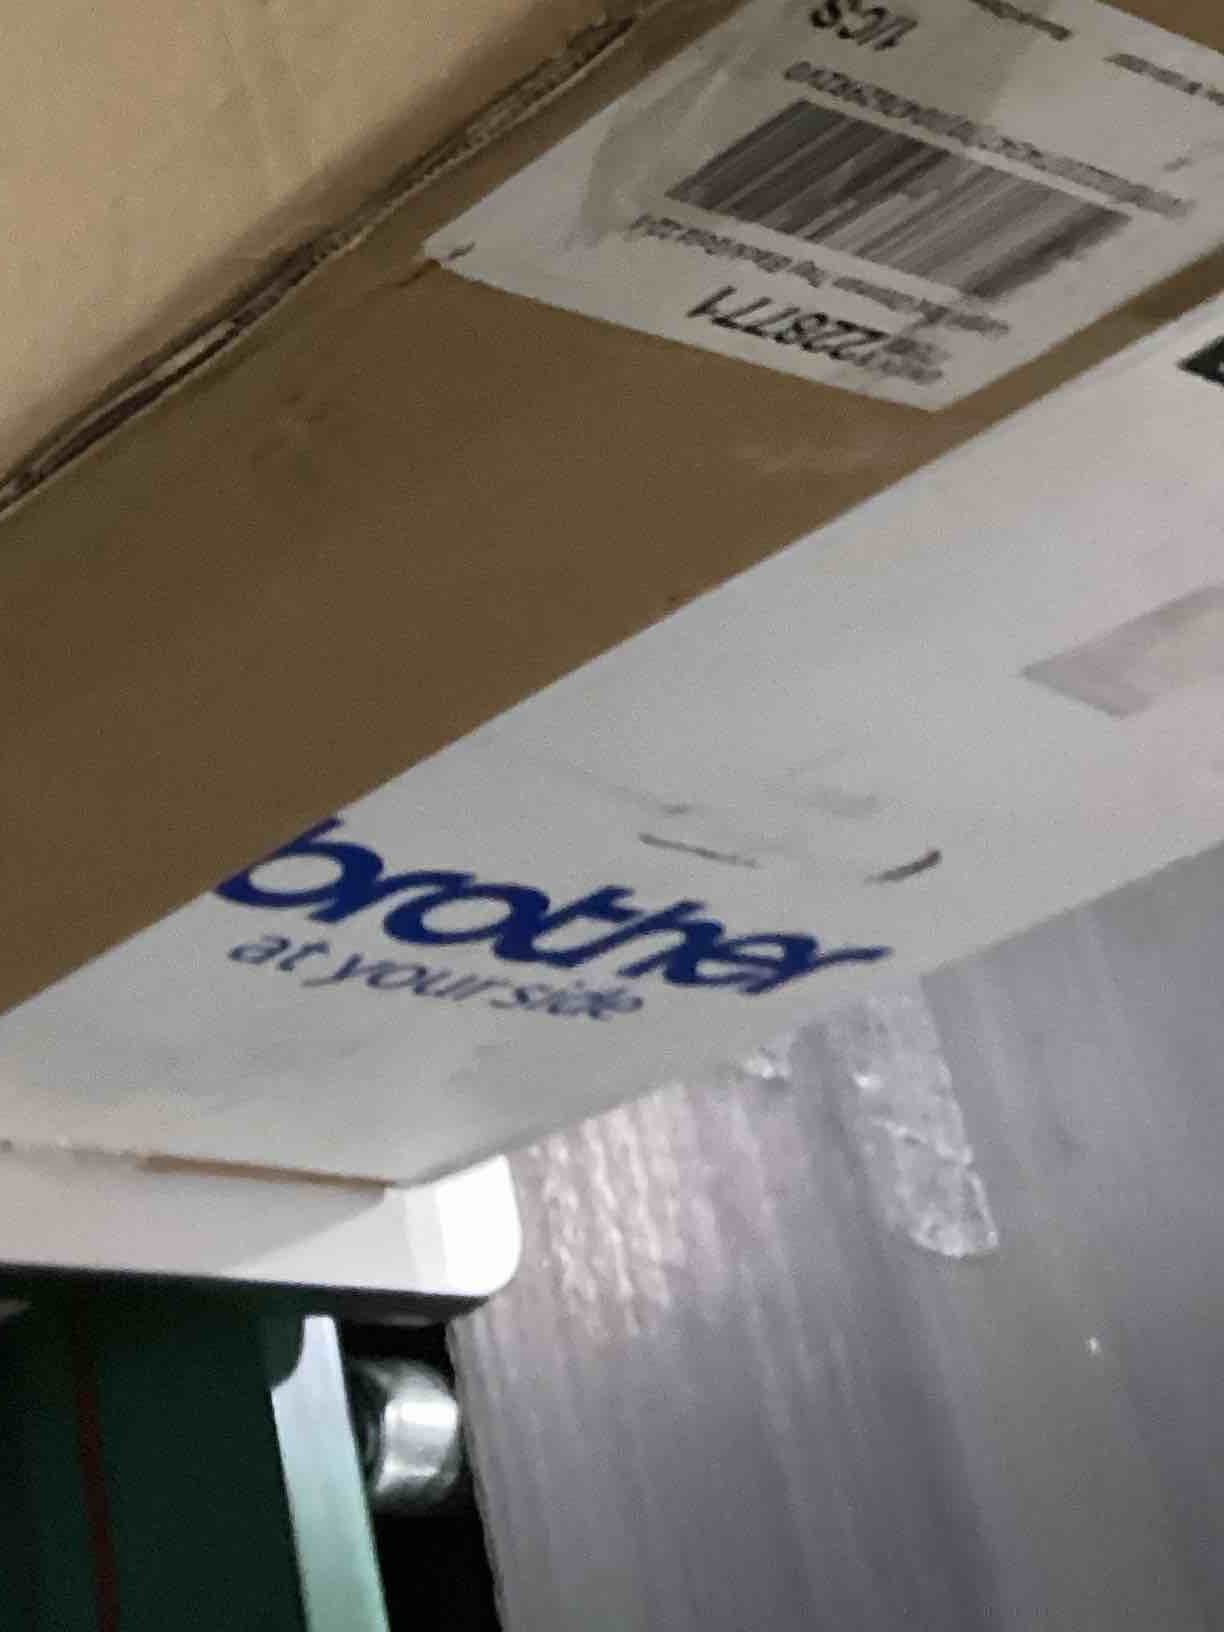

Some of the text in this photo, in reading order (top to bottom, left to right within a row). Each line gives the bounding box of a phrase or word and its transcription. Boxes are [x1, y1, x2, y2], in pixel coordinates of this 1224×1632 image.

[216, 817, 892, 994] brother
[227, 934, 645, 1021] at your side
